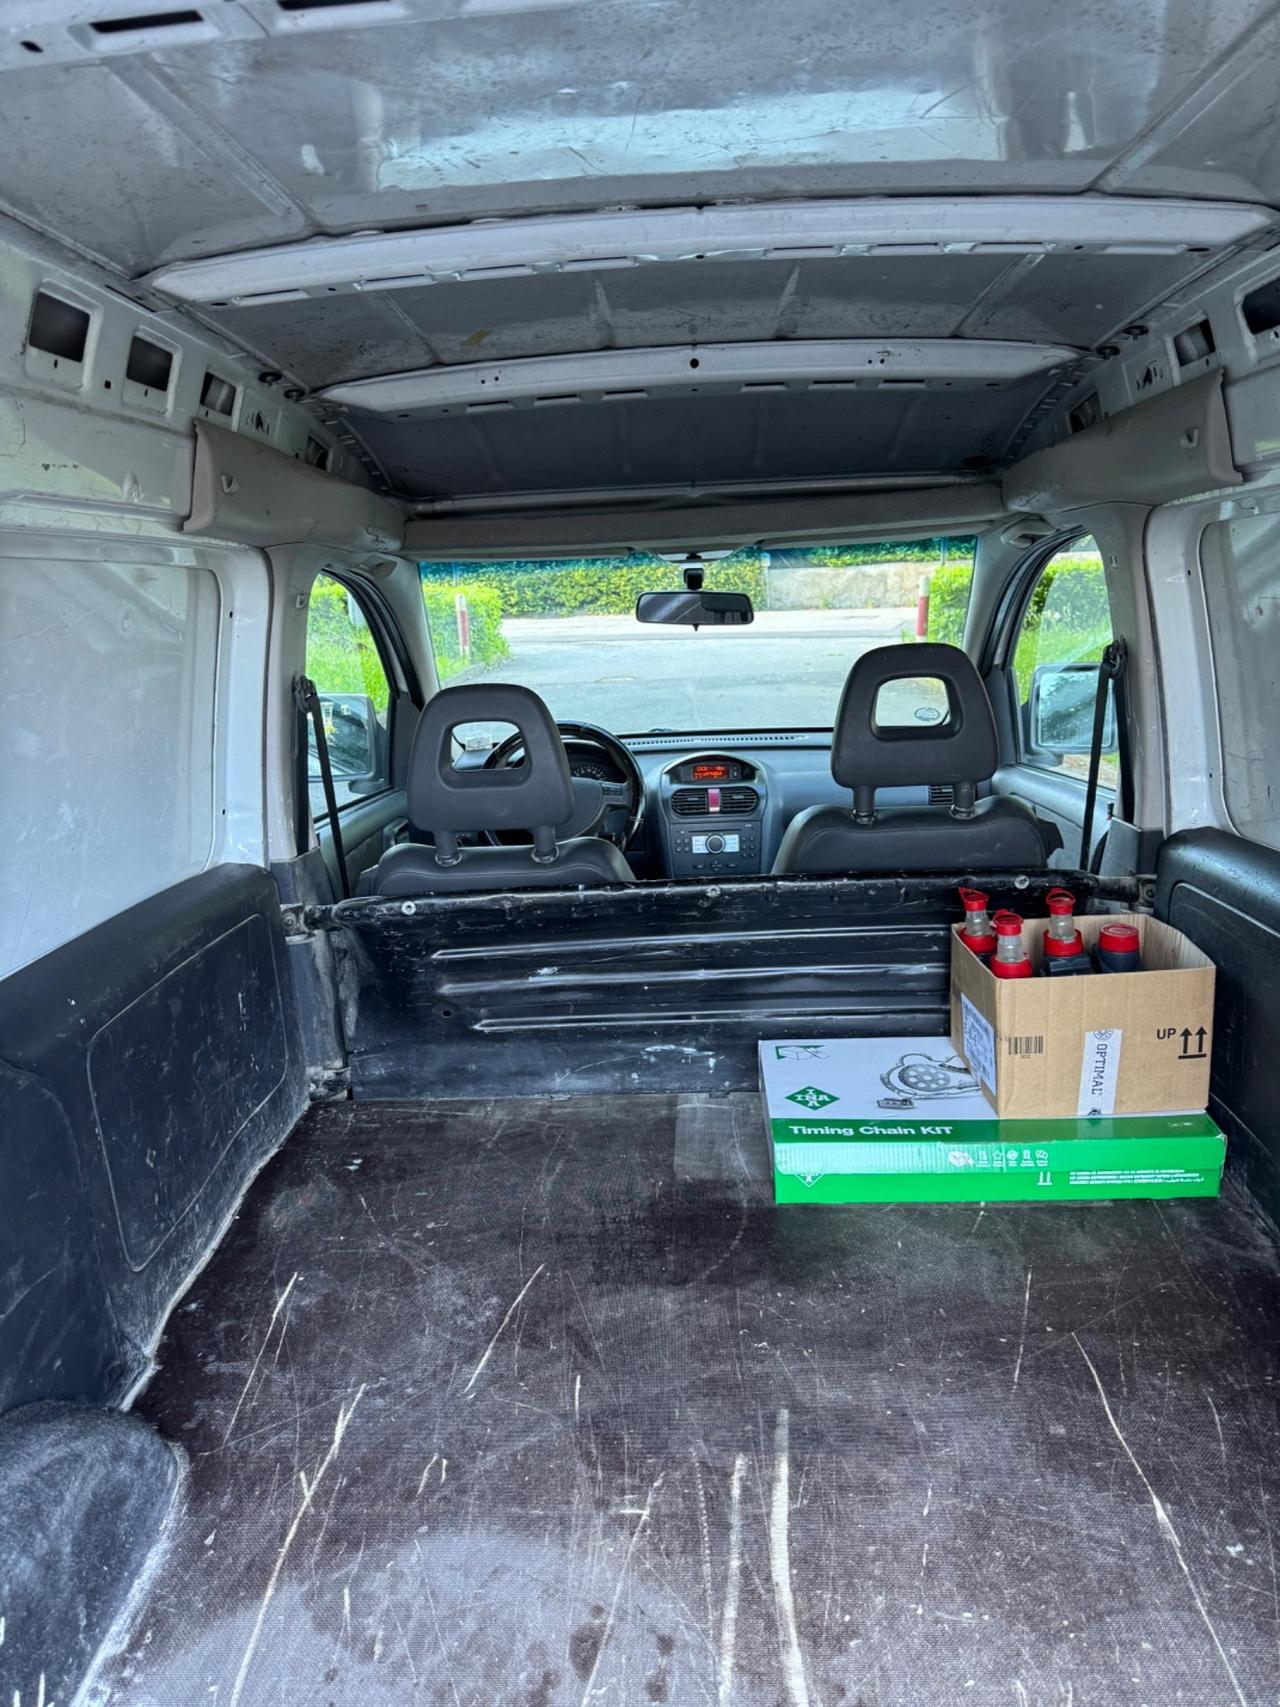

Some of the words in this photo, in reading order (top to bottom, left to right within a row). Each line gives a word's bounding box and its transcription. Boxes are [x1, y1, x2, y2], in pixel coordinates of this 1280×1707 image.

[1156, 1028, 1177, 1040] UP
[1091, 1043, 1108, 1095] OPTIMAL
[789, 1126, 854, 1136] Timing
[859, 1126, 915, 1135] Chain
[920, 1126, 953, 1135] KIT
